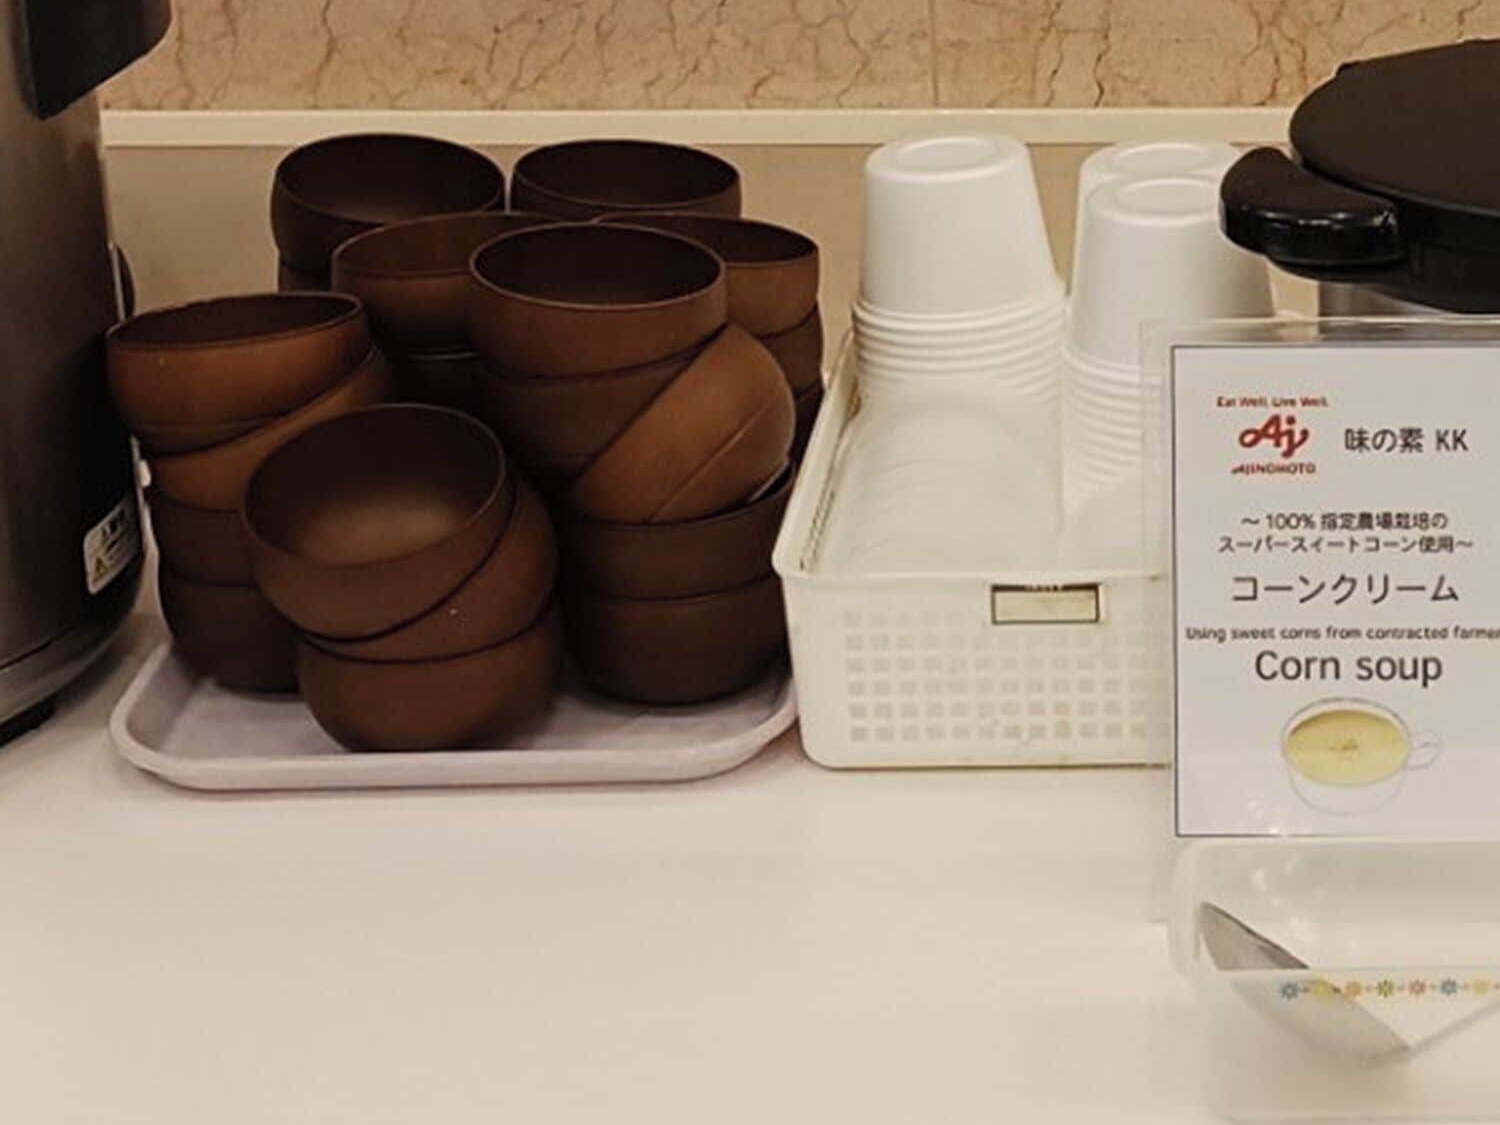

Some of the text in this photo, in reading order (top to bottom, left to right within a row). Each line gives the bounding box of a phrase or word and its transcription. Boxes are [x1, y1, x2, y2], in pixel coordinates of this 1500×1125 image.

[1344, 427, 1468, 453] 味の素 KK
[1232, 573, 1460, 605] コーンクリーム
[1186, 626, 1227, 644] Using
[1231, 627, 1275, 640] sweet
[1280, 627, 1321, 640] corns
[1326, 625, 1361, 640] from
[1366, 626, 1449, 640] contracted
[1255, 650, 1443, 689] Corn soup
